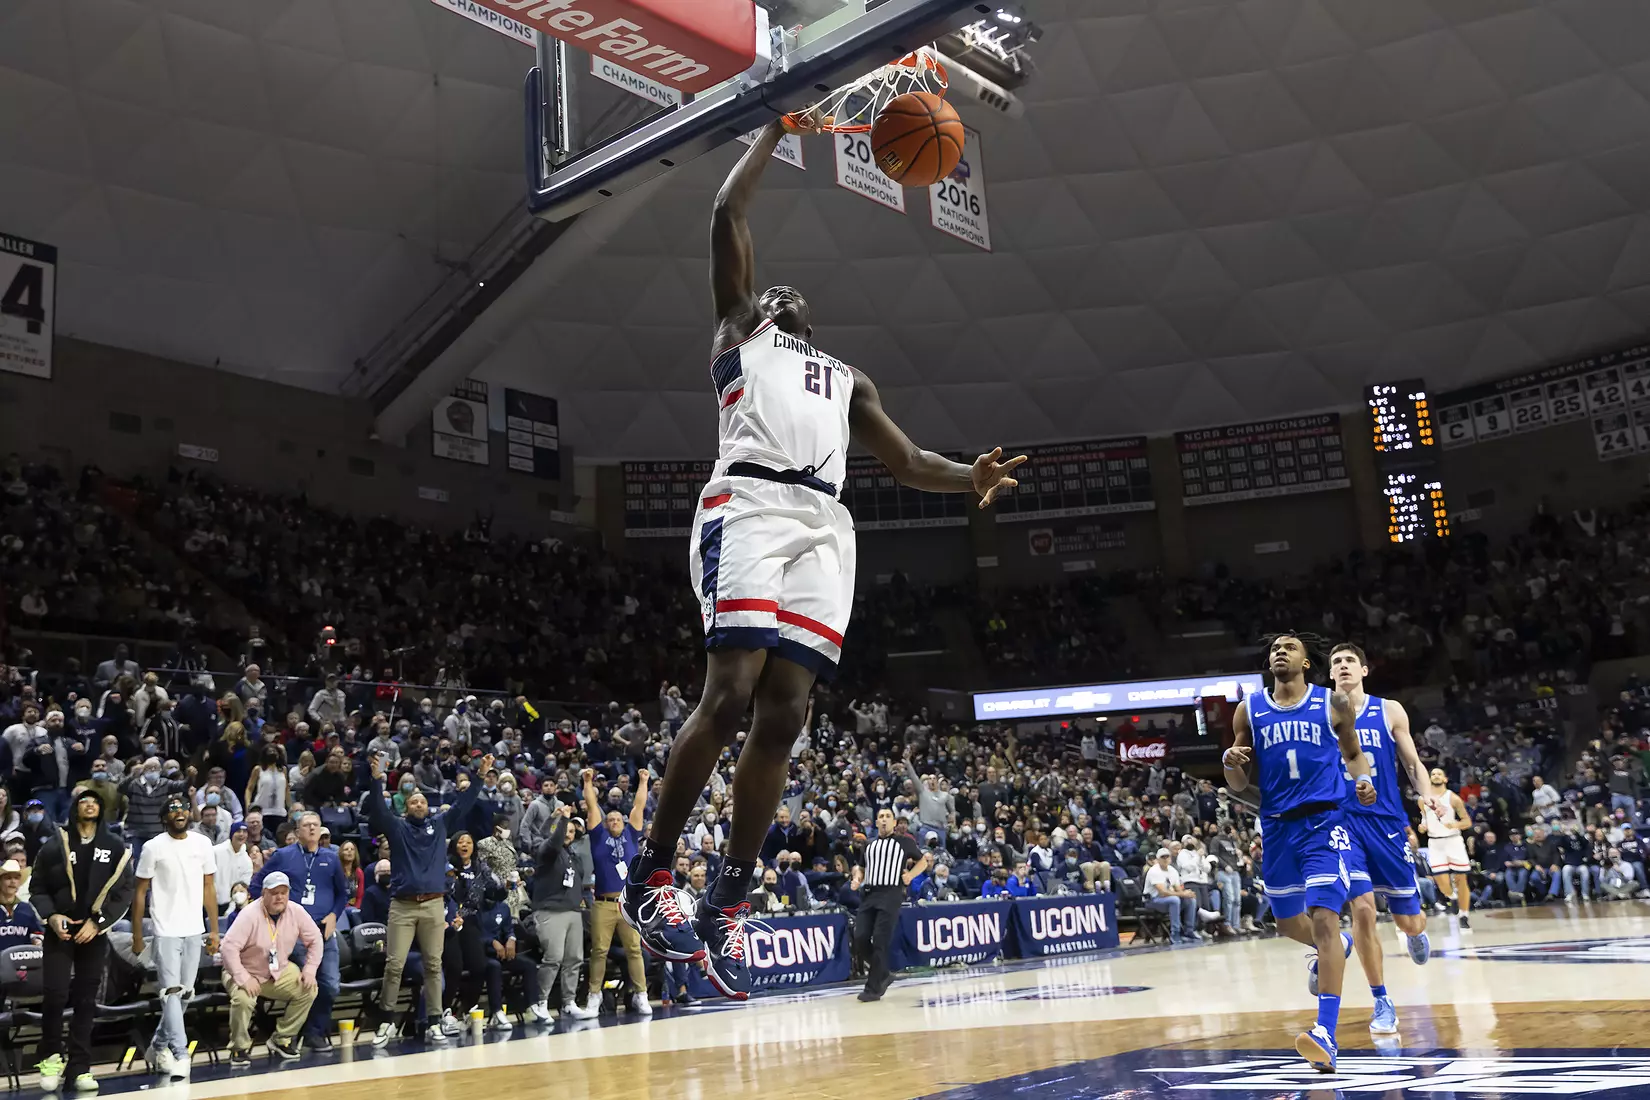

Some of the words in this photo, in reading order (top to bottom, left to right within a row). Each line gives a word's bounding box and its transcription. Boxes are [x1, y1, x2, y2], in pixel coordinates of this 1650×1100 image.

[574, 17, 710, 82] Farm
[602, 64, 674, 105] CHAMPIONS
[847, 161, 893, 190] NATIONAL
[845, 174, 898, 206] CHAMPIONS
[938, 179, 980, 216] 2016
[940, 205, 980, 231] NATIONAL
[938, 217, 985, 245] CHAMPIONS
[805, 360, 832, 400] 21
[1553, 395, 1580, 415] 25
[1593, 386, 1620, 405] 42
[1487, 415, 1498, 430] 9
[1516, 405, 1543, 424] 22
[1183, 431, 1220, 442] NCAA
[1226, 415, 1331, 437] CHAMPIONSHIP
[1449, 423, 1465, 439] C
[1601, 431, 1629, 452] 24
[625, 463, 647, 473] BIG
[653, 462, 686, 473] EAST
[1536, 697, 1559, 710] 113
[1260, 720, 1322, 750] XAVIER
[1355, 728, 1382, 749] IER
[1285, 748, 1300, 780] 1
[724, 865, 742, 877] 23
[360, 927, 386, 937] UCONN
[917, 911, 1000, 953] UCONN
[1029, 903, 1107, 940] UCONN
[10, 950, 44, 961] UCONN
[1043, 938, 1097, 955] BASKETBALL
